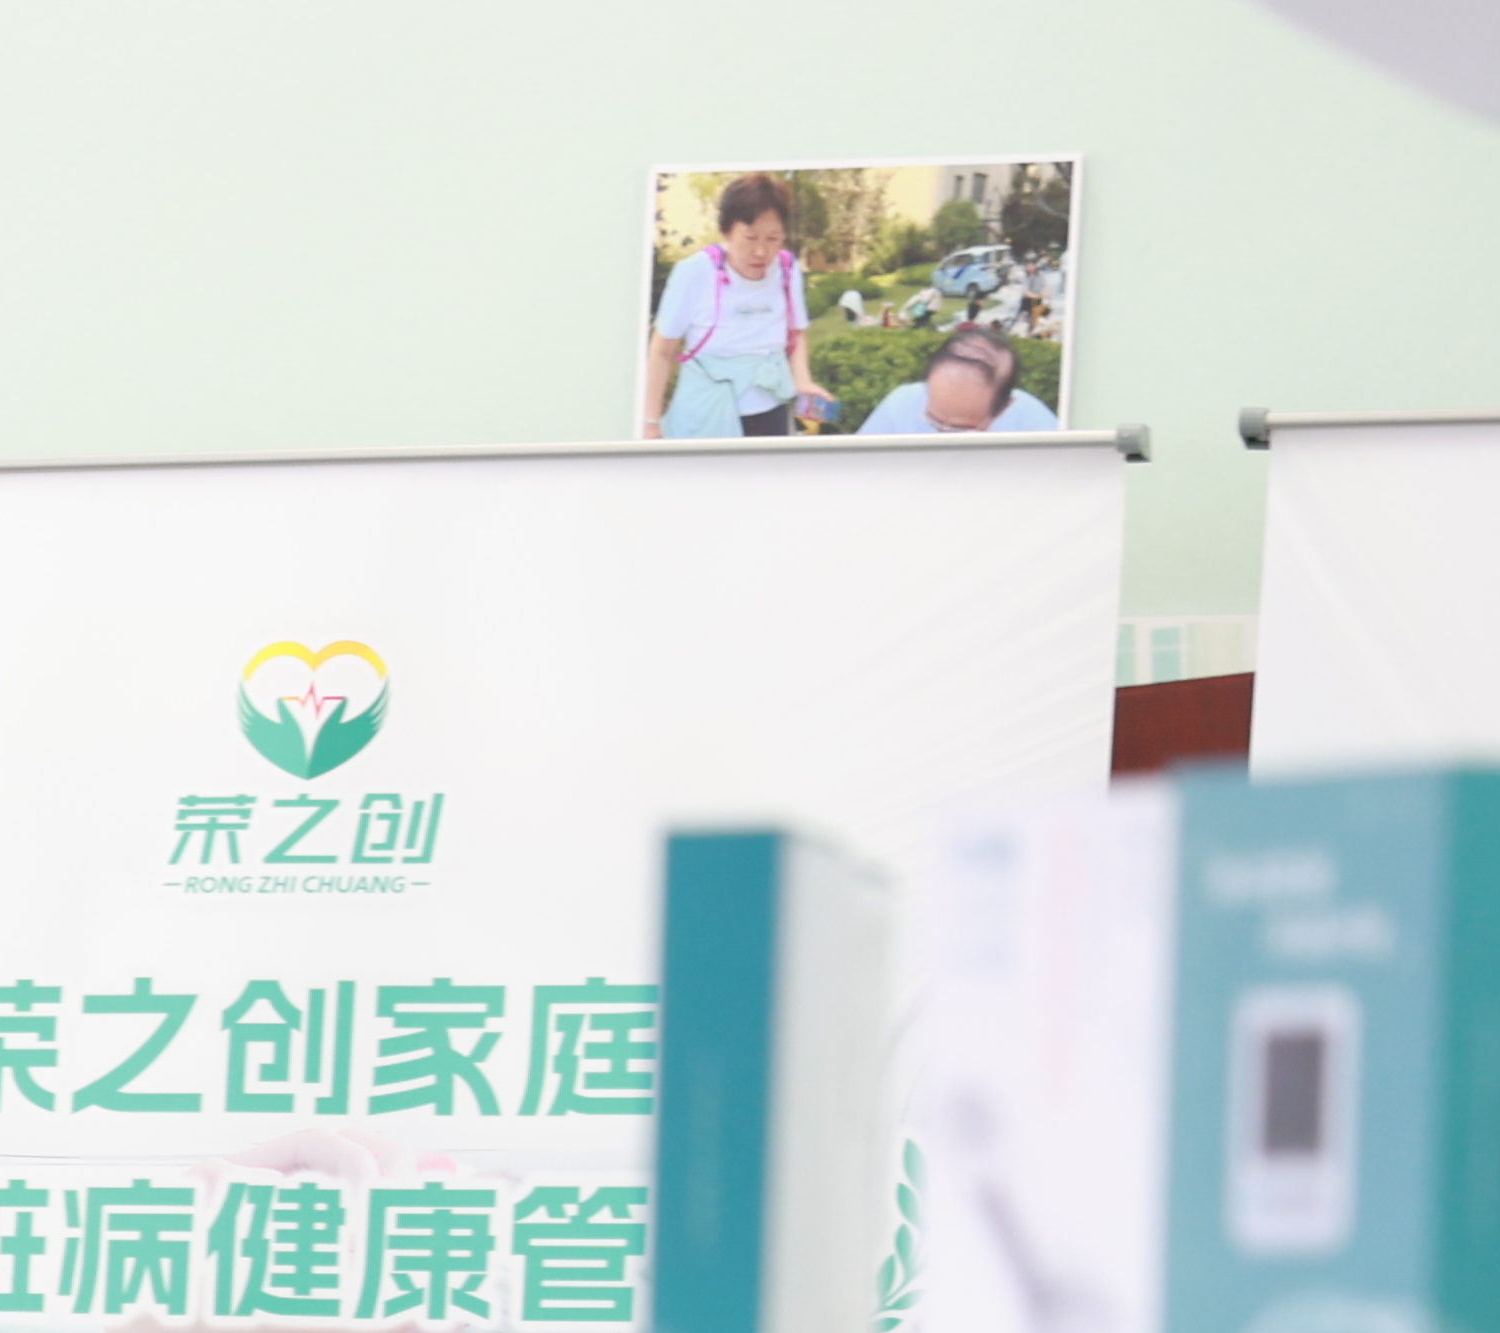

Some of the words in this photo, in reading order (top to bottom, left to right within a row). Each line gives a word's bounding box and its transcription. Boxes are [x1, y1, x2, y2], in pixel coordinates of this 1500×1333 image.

[167, 793, 445, 865] 荣之创
[183, 875, 252, 894] RONG
[257, 875, 297, 894] ZHI
[302, 875, 406, 894] CHUANG
